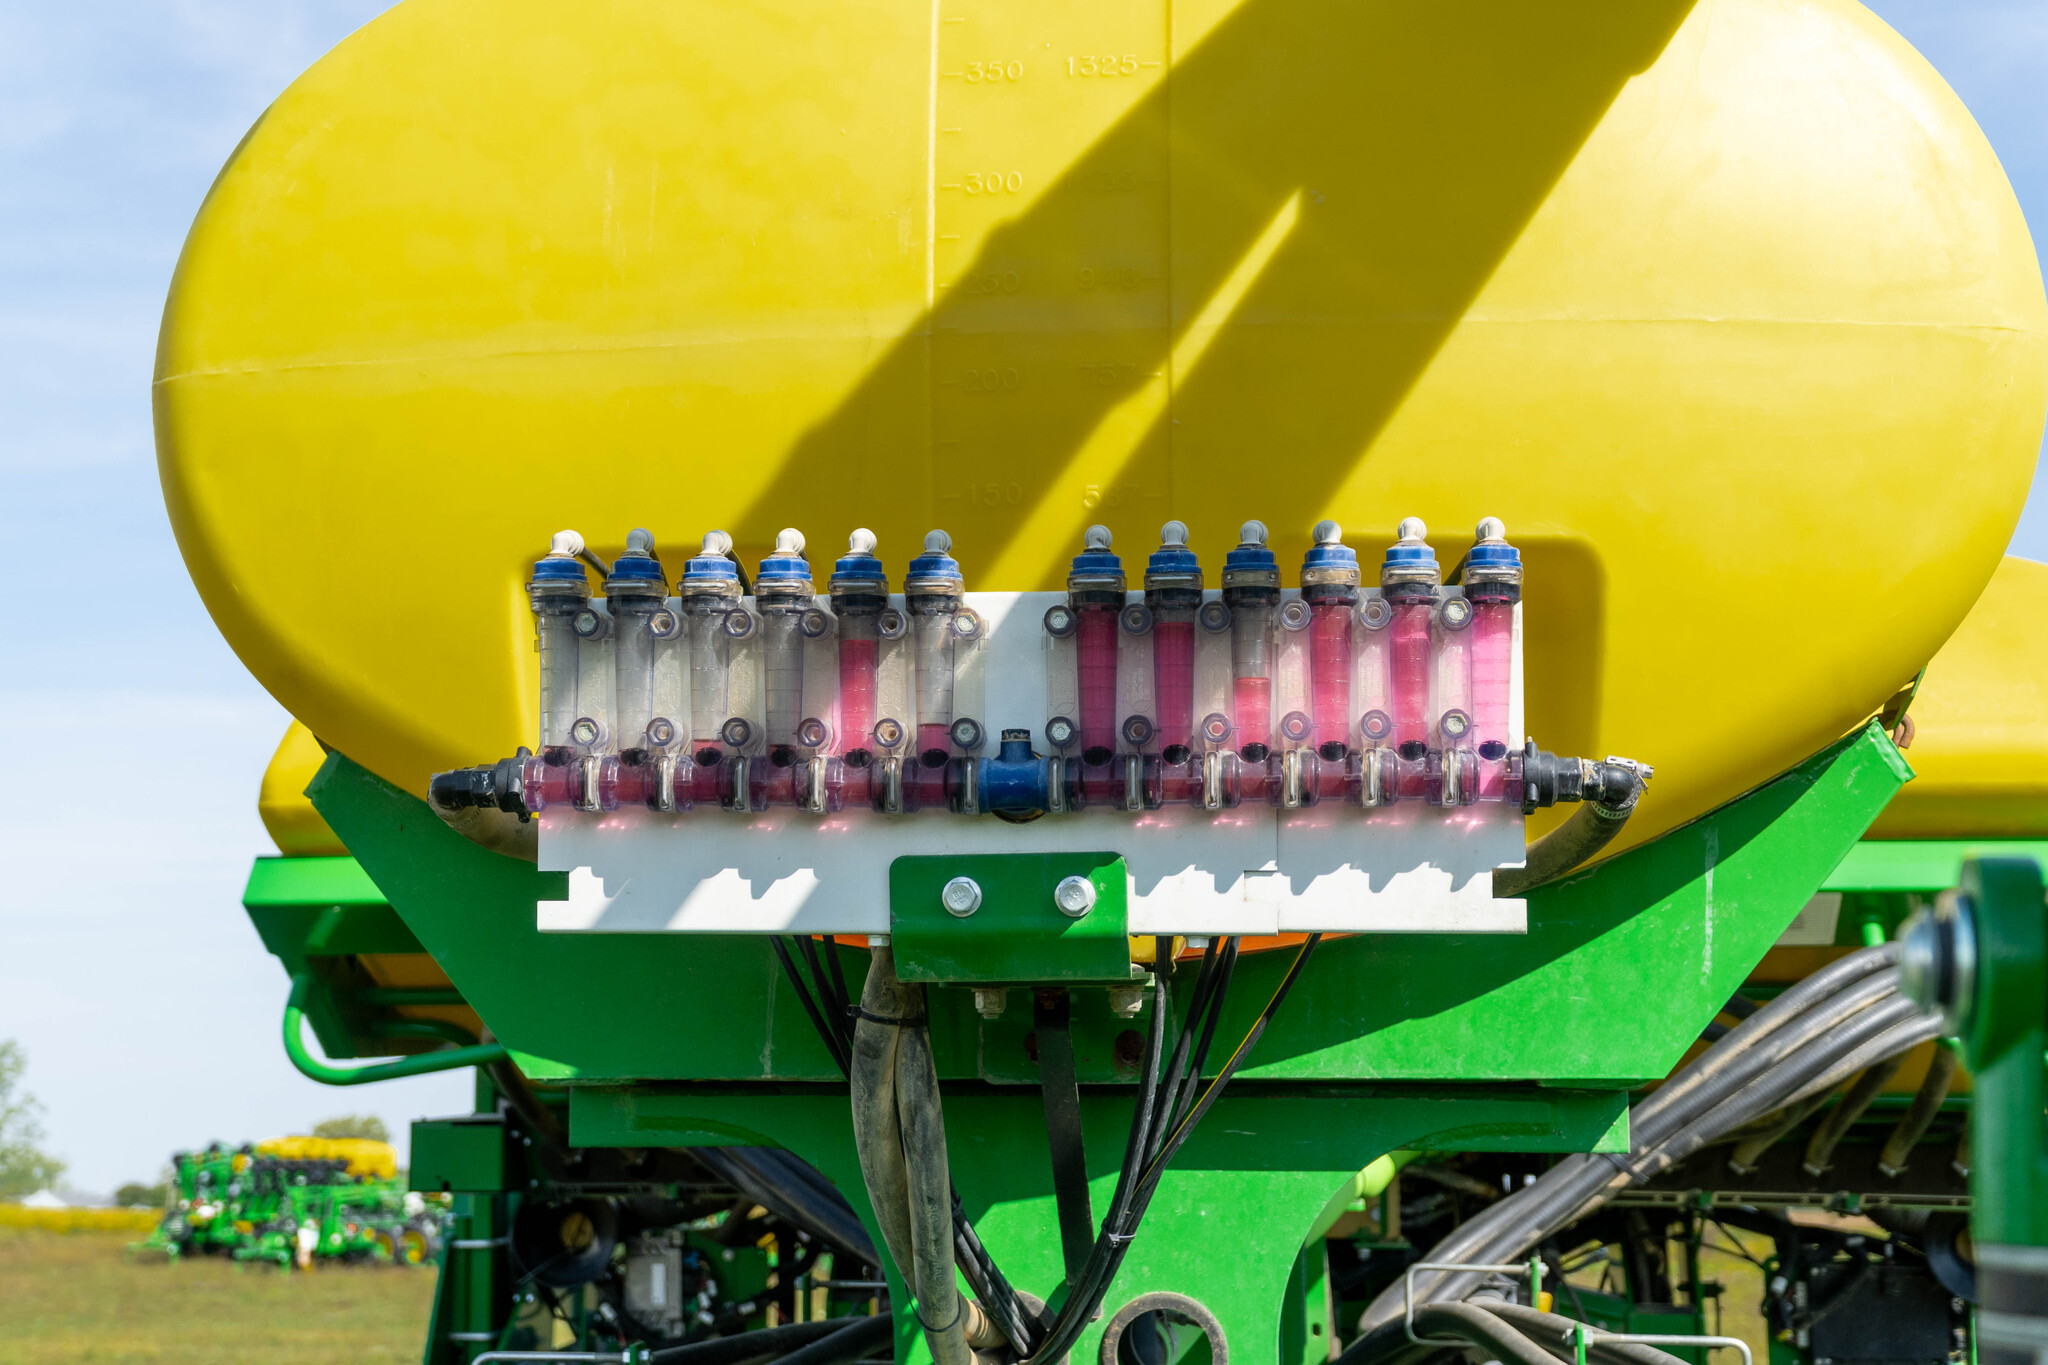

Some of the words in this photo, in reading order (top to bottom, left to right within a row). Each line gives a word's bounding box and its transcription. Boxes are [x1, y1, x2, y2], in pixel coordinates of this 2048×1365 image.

[966, 59, 1023, 82] 350
[1066, 54, 1137, 77] 1325
[965, 171, 1022, 194] 300
[963, 367, 1020, 392] 200
[967, 481, 1022, 506] 150
